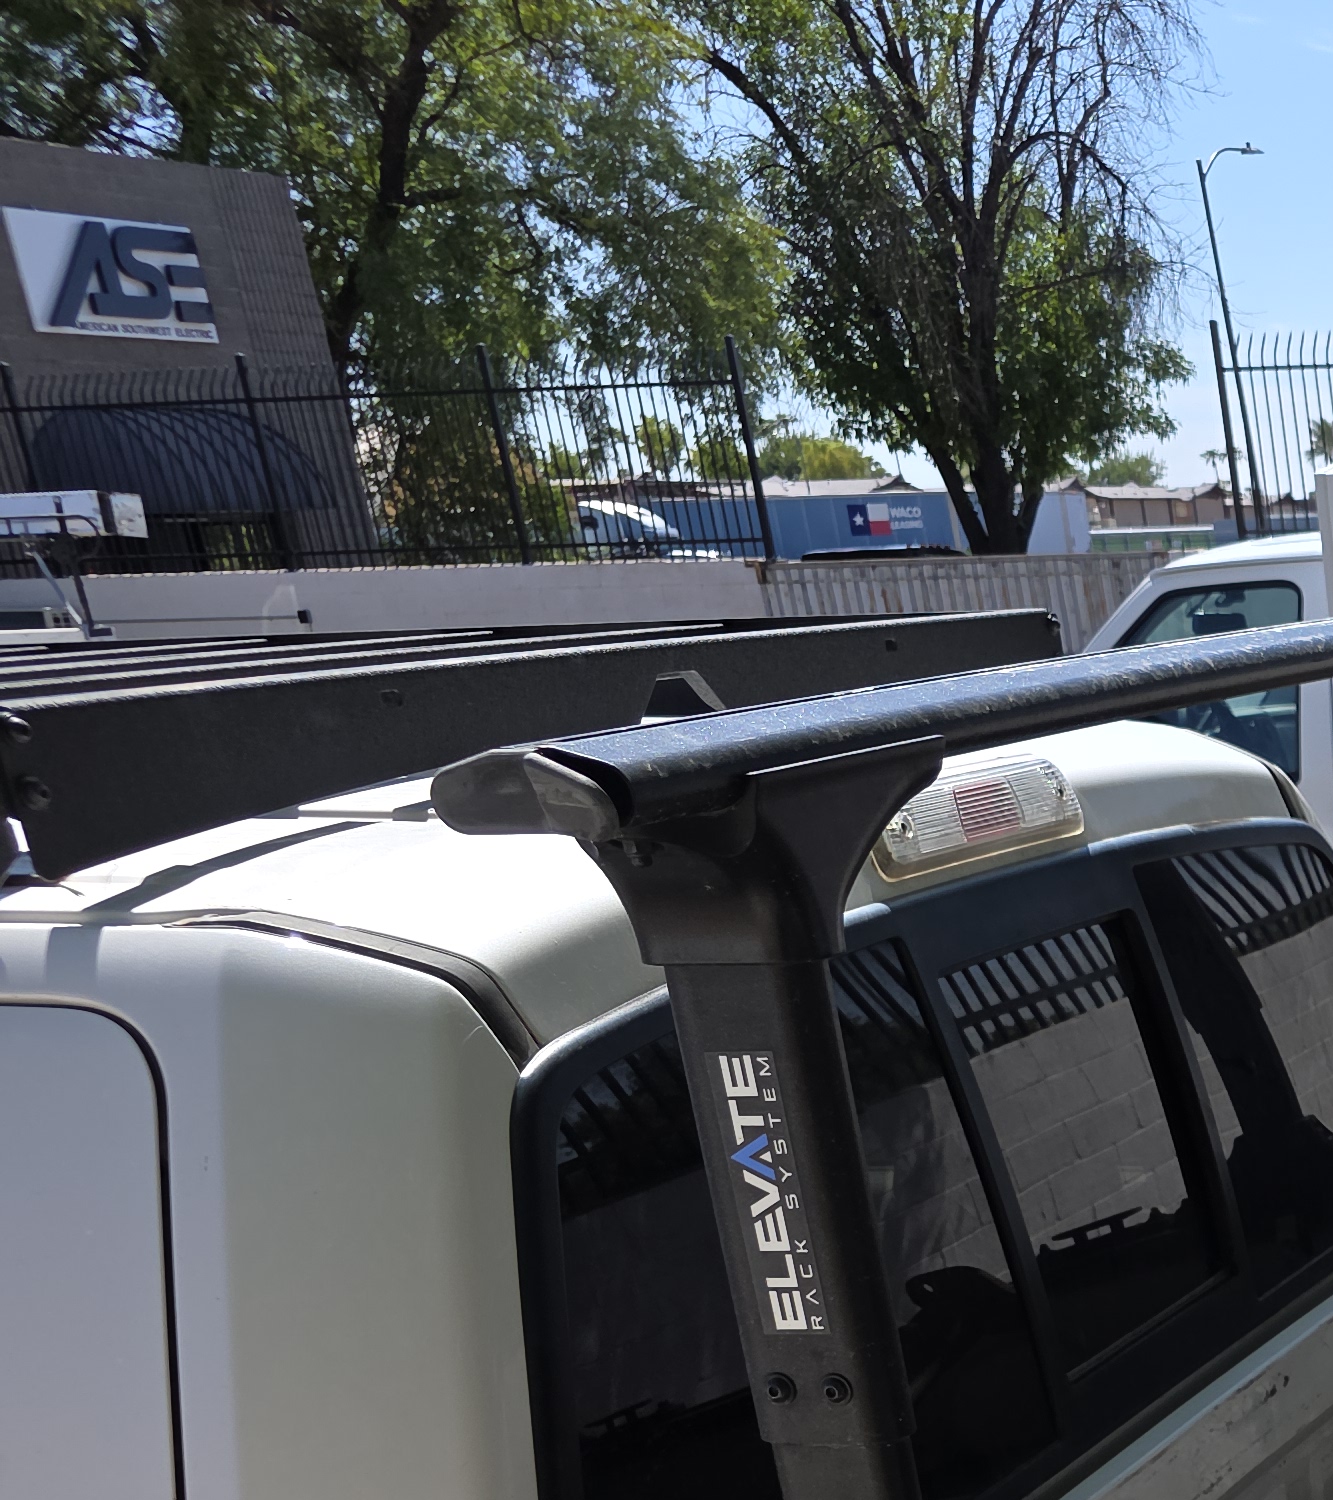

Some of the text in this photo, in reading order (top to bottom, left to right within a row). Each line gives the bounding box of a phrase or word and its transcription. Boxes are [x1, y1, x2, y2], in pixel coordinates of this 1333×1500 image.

[50, 221, 215, 326] ASE
[719, 1054, 808, 1331] ELEVATE
[756, 1056, 825, 1331] RACK SYSTEM
